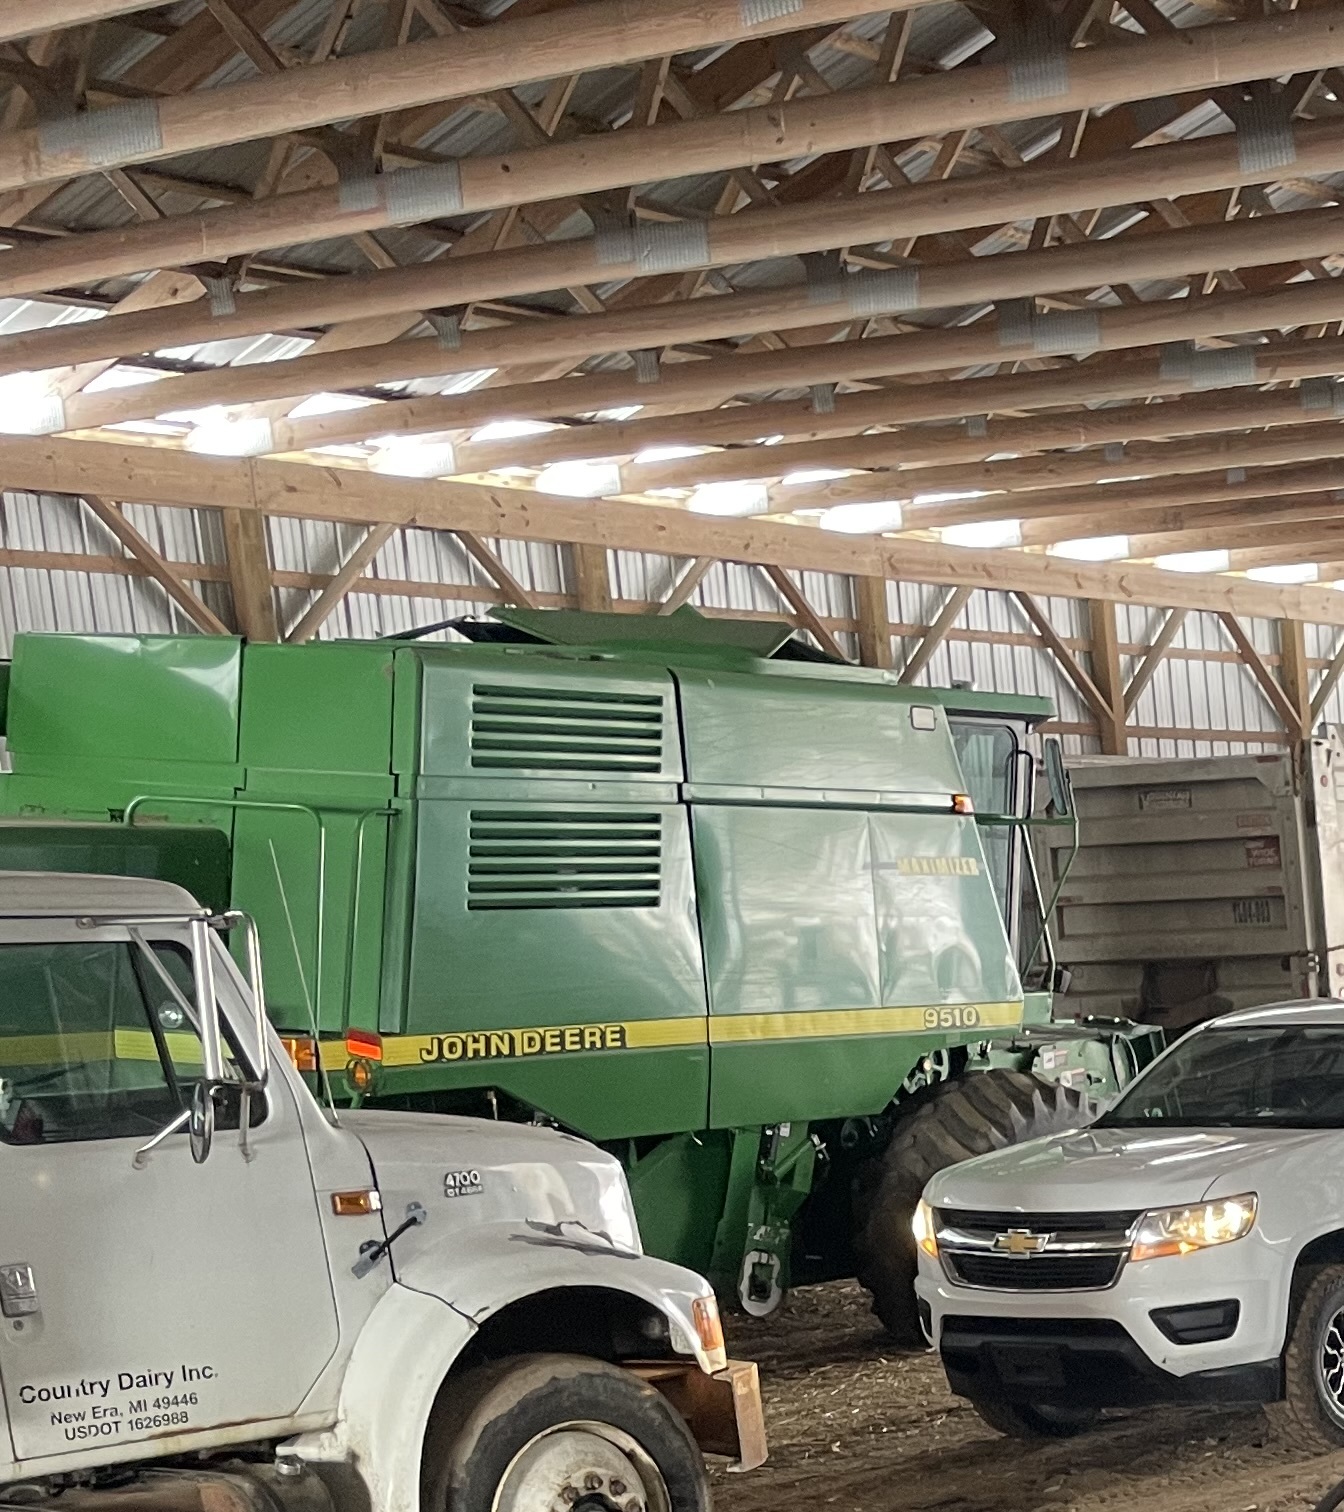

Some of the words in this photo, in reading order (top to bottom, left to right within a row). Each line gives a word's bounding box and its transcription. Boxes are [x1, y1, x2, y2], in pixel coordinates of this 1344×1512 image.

[924, 1006, 979, 1029] 9510
[420, 1032, 512, 1062] JOHN
[521, 1025, 624, 1054] DEERE
[19, 1379, 110, 1404] Country
[117, 1368, 174, 1391] Dairy
[181, 1364, 219, 1382] Inc.
[50, 1411, 86, 1425] New
[92, 1405, 123, 1419] Era,
[129, 1398, 147, 1414] MI
[153, 1392, 198, 1409] 49446
[64, 1420, 121, 1440] USDOT
[127, 1411, 189, 1431] 1626988
